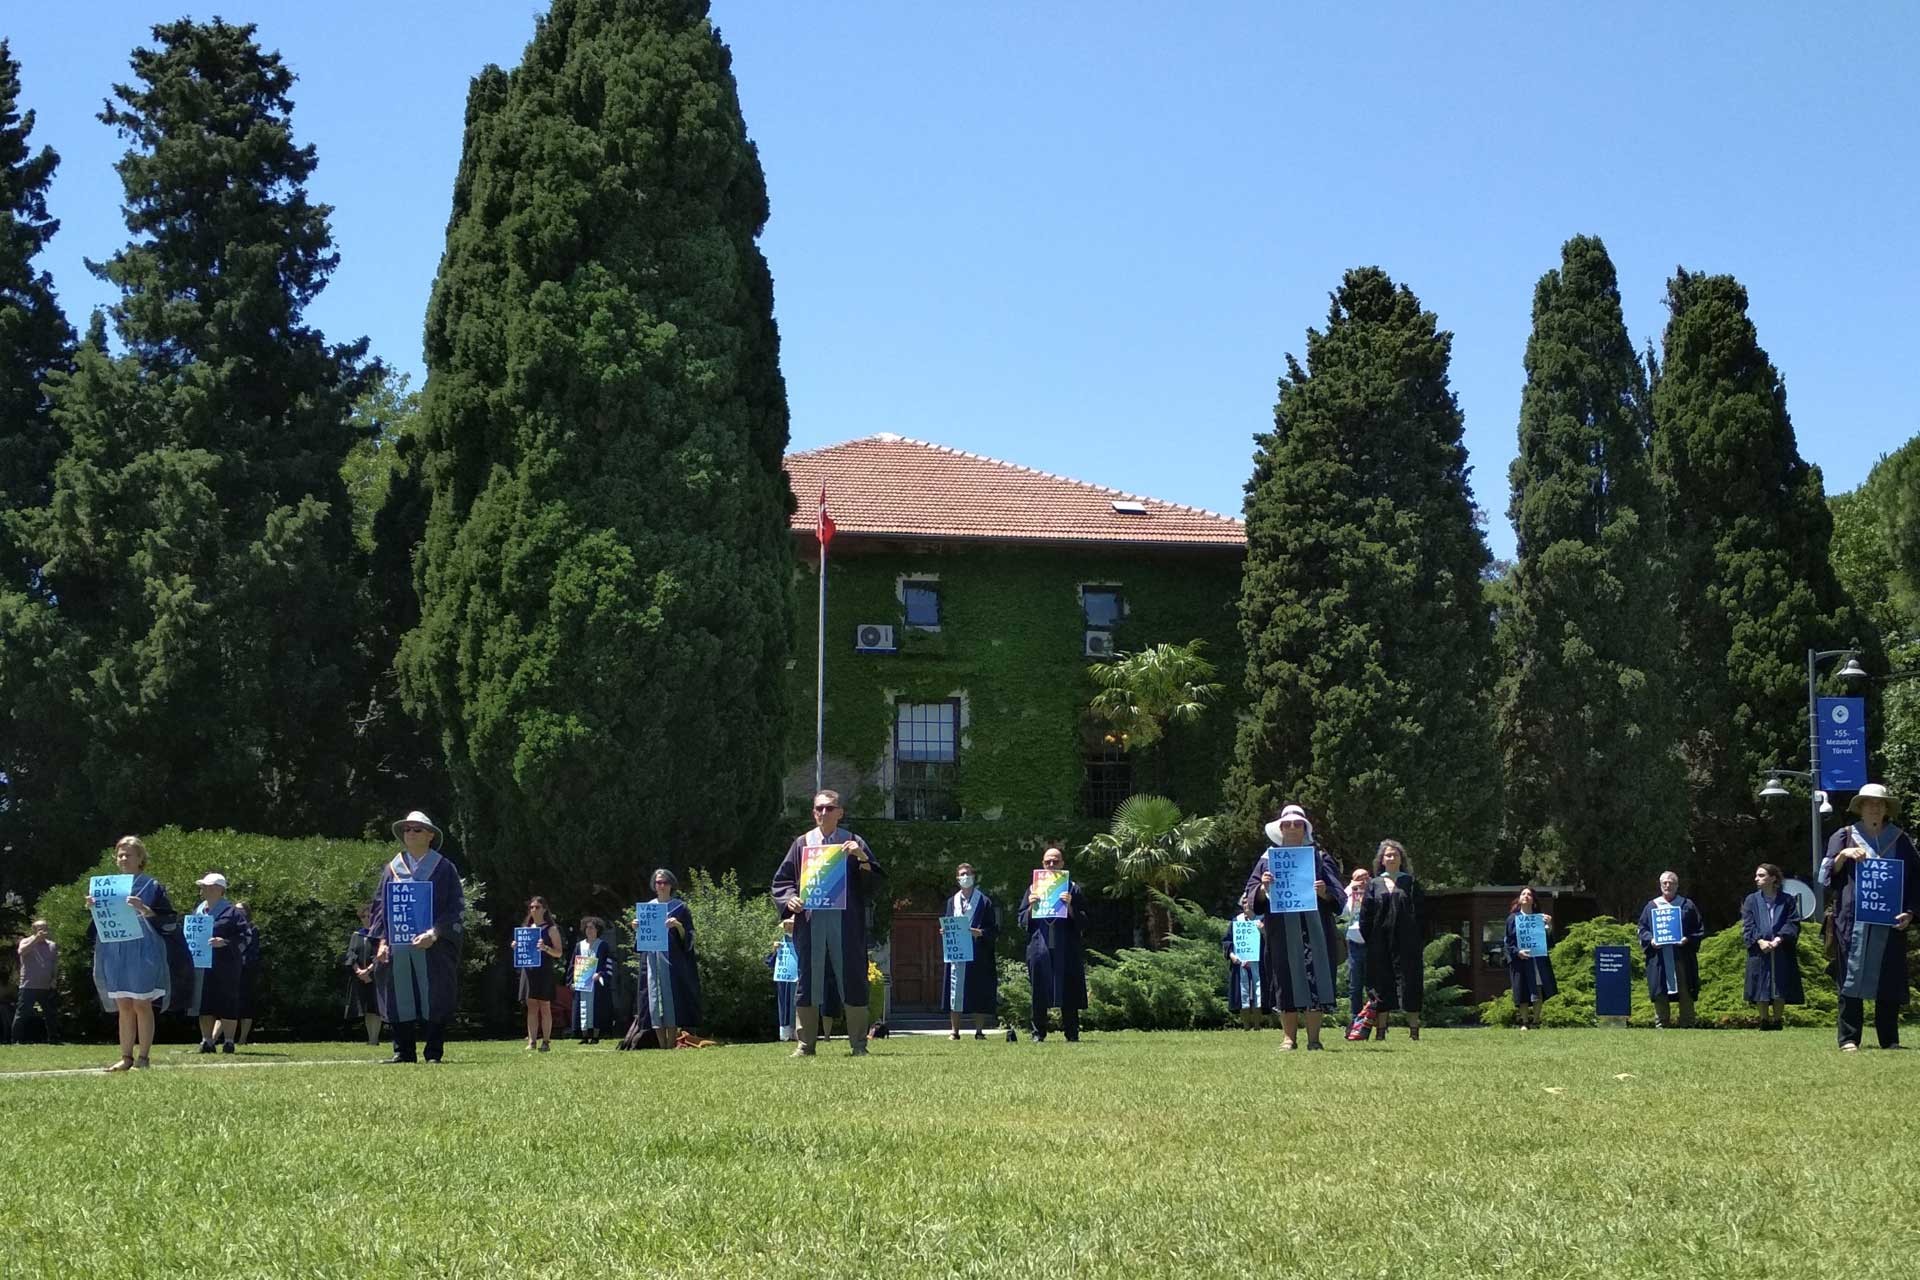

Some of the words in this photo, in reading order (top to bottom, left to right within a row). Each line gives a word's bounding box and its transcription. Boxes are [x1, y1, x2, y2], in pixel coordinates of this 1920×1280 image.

[1274, 851, 1296, 859] KA-
[1274, 861, 1298, 869] BUL
[1862, 860, 1893, 869] VAZ-
[1275, 871, 1294, 879] ET-
[1862, 870, 1893, 881] GEÇ-
[95, 878, 116, 887] KA-
[1276, 879, 1295, 889] Mİ-
[1862, 879, 1883, 889] Mİ-
[94, 888, 117, 897] BUL
[392, 884, 415, 893] KA-
[806, 887, 828, 896] YO-
[392, 894, 416, 902] BUL
[1276, 890, 1298, 899] YO-
[1862, 890, 1885, 900] YO-
[95, 900, 114, 908] ET-
[805, 897, 835, 906] RUZ.
[1277, 900, 1305, 908] RUZ.
[1861, 901, 1891, 911] RUZ.
[393, 904, 412, 912] ET-
[96, 908, 116, 919] Mİ-
[393, 912, 412, 922] Mİ-
[100, 920, 121, 928] YO-
[394, 924, 414, 932] YO-
[103, 930, 132, 938] RUZ.
